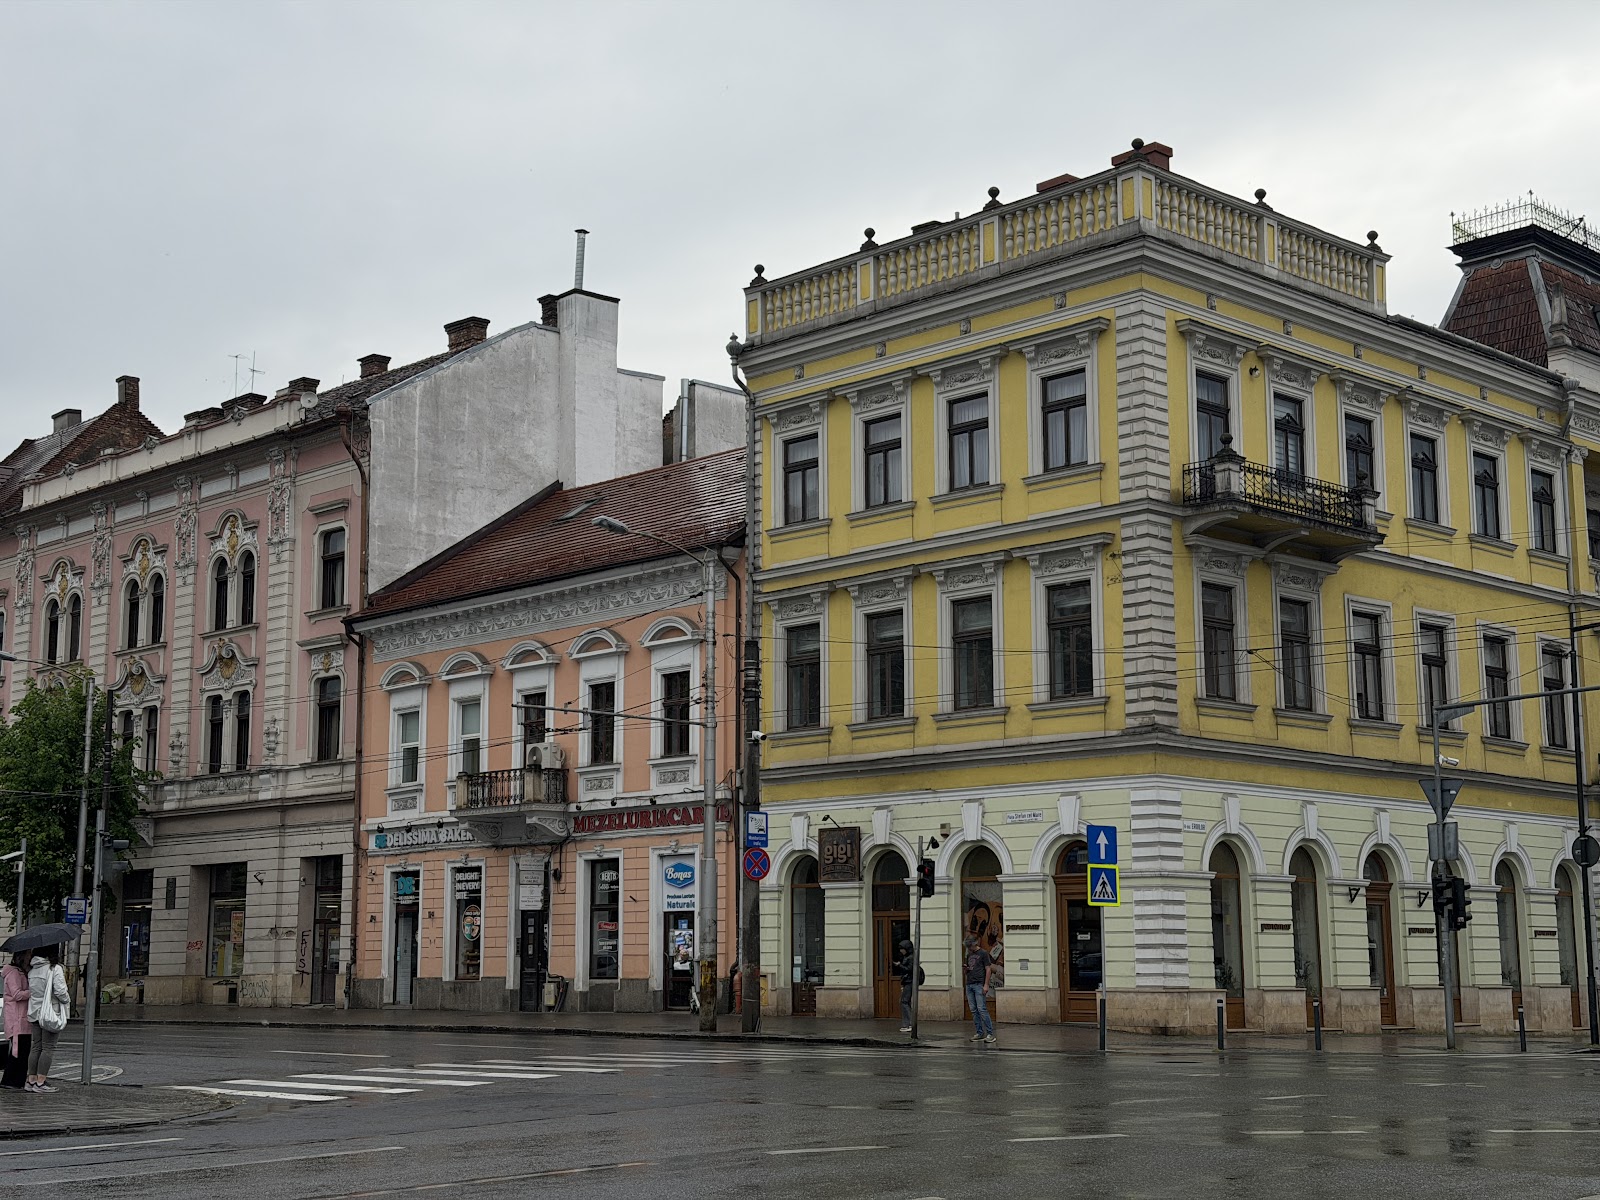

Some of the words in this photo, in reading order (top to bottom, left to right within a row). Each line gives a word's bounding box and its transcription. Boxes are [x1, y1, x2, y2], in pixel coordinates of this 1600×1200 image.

[386, 828, 437, 847] DELISSIMA
[440, 826, 477, 842] BAKER
[824, 840, 851, 864] gigi
[456, 872, 478, 880] DELIGHT
[665, 867, 692, 881] Bonas
[462, 882, 479, 890] EVERY
